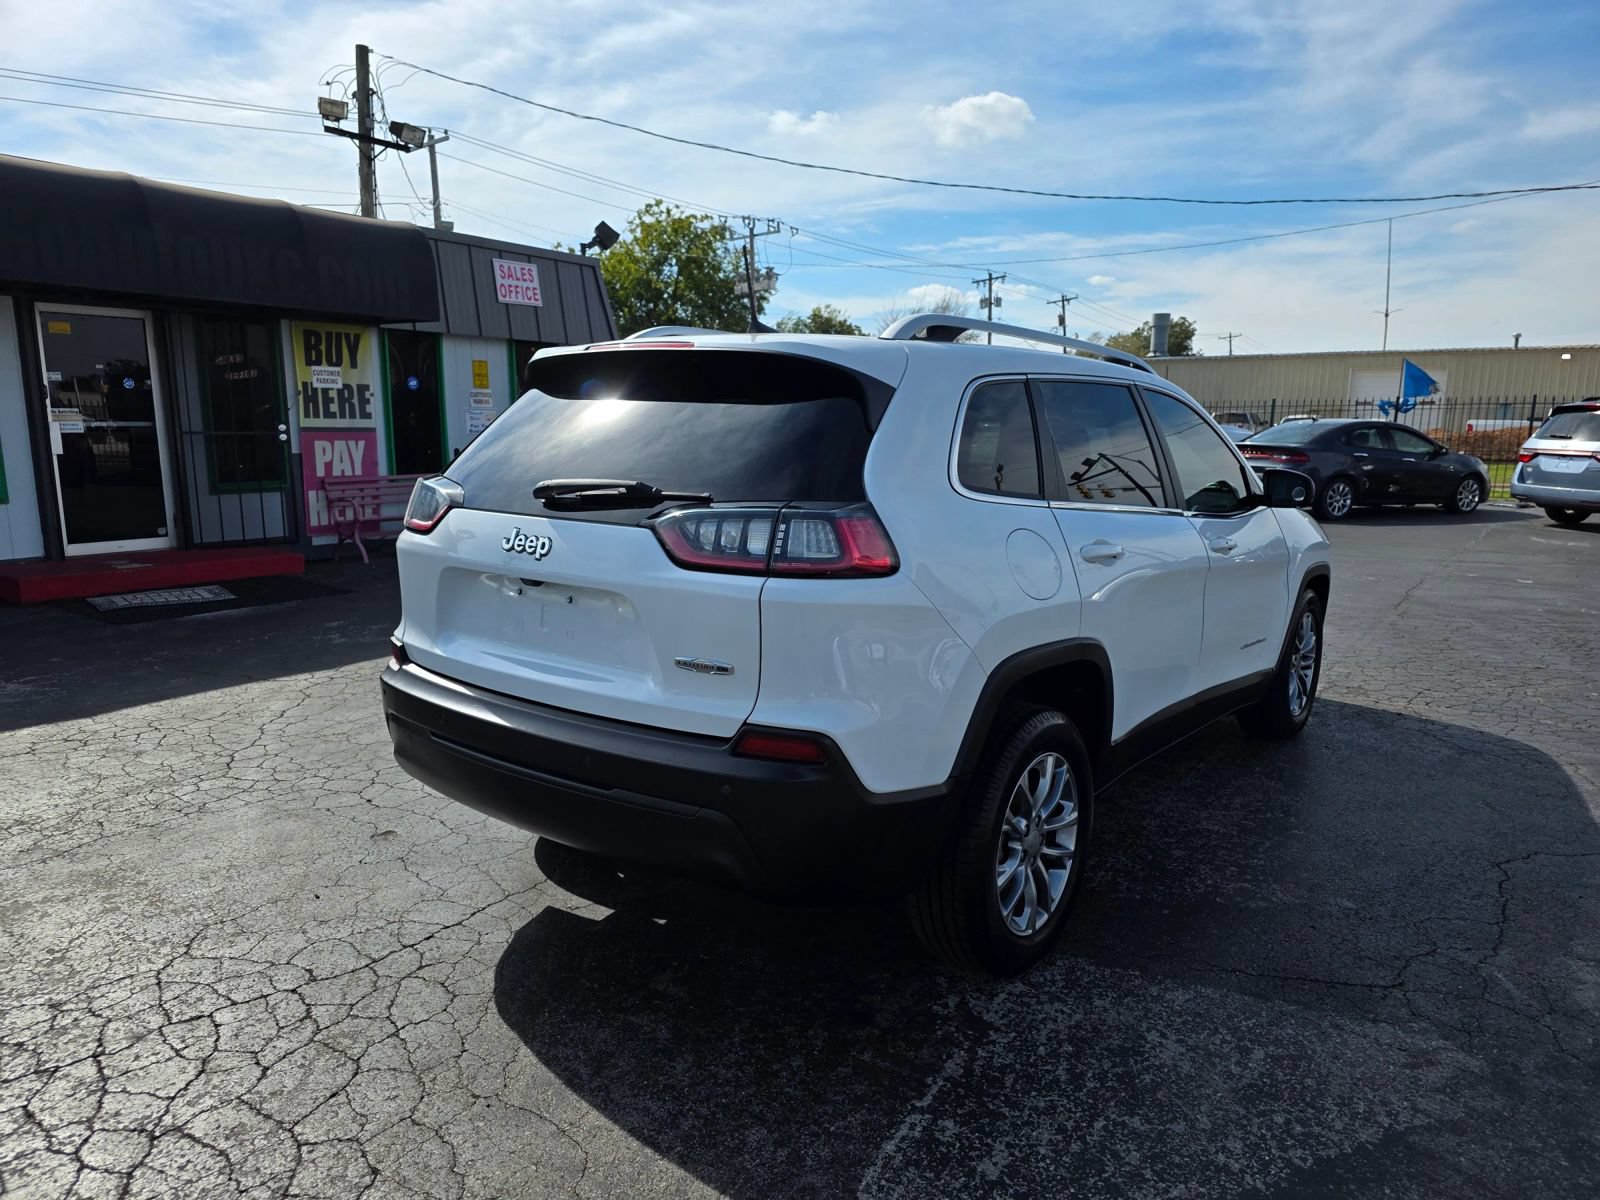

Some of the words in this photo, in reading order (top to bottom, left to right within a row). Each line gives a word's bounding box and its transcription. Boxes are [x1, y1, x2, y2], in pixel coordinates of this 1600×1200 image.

[498, 264, 535, 284] SALES
[499, 283, 540, 303] OFFICE
[303, 330, 360, 369] BUY
[312, 369, 340, 377] CUSTOMER
[316, 377, 339, 385] PARKING
[301, 382, 373, 419] HERE
[313, 439, 366, 477] PAY
[502, 527, 552, 561] Jeep
